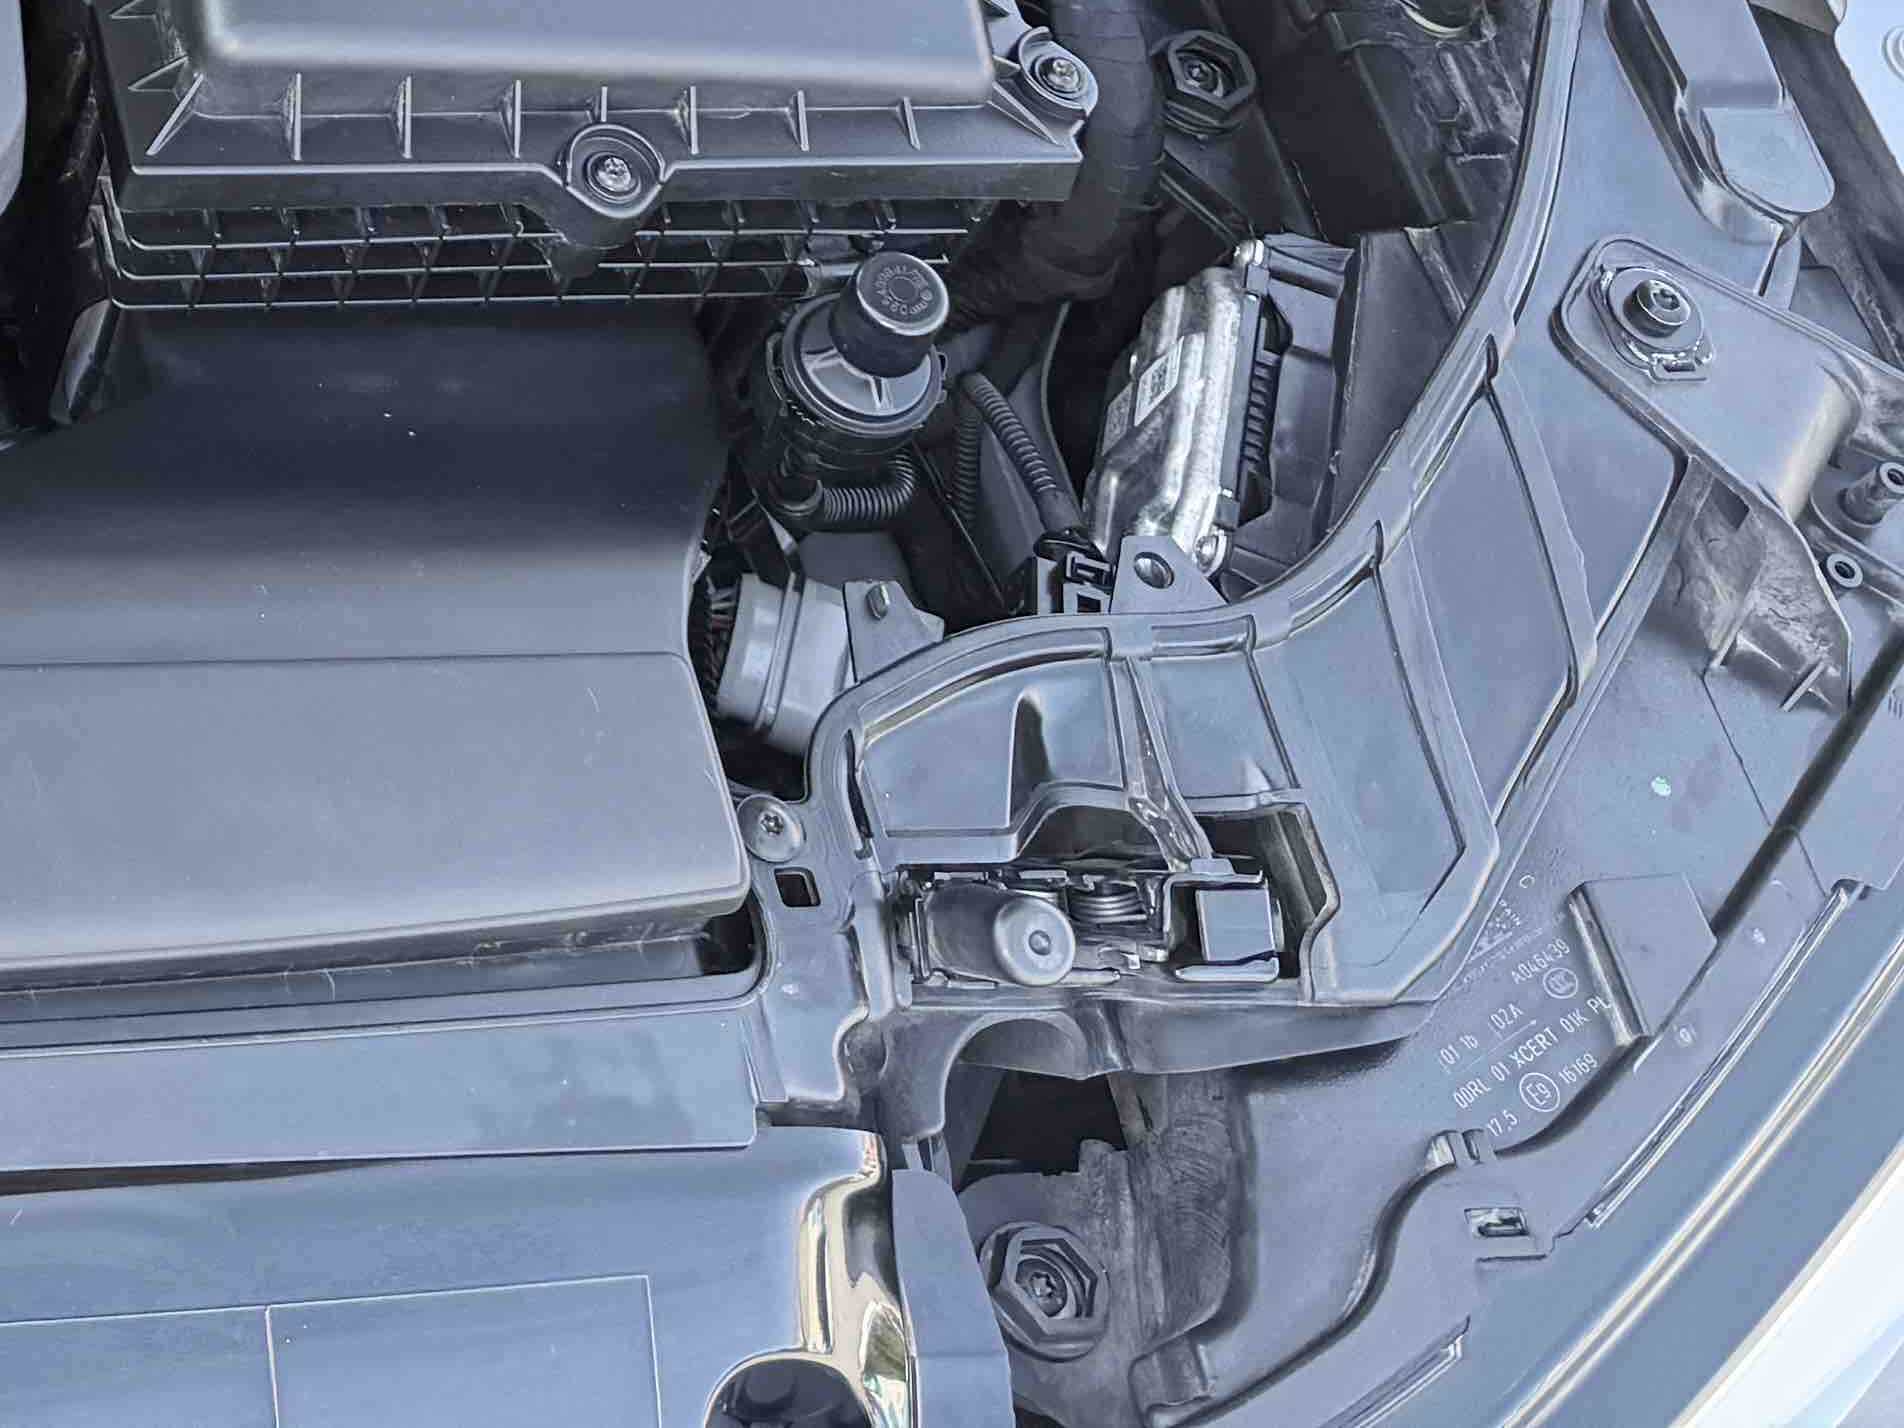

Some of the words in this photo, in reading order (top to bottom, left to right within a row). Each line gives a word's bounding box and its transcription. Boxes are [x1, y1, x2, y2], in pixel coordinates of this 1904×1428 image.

[1511, 939, 1571, 985] A046439
[1496, 1002, 1527, 1030] 02A
[1508, 1027, 1559, 1072] XCERT
[1560, 1008, 1591, 1034] 01K
[1589, 994, 1613, 1017] PL
[1487, 1110, 1520, 1138] 17.5
[1558, 1052, 1599, 1086] 16169
